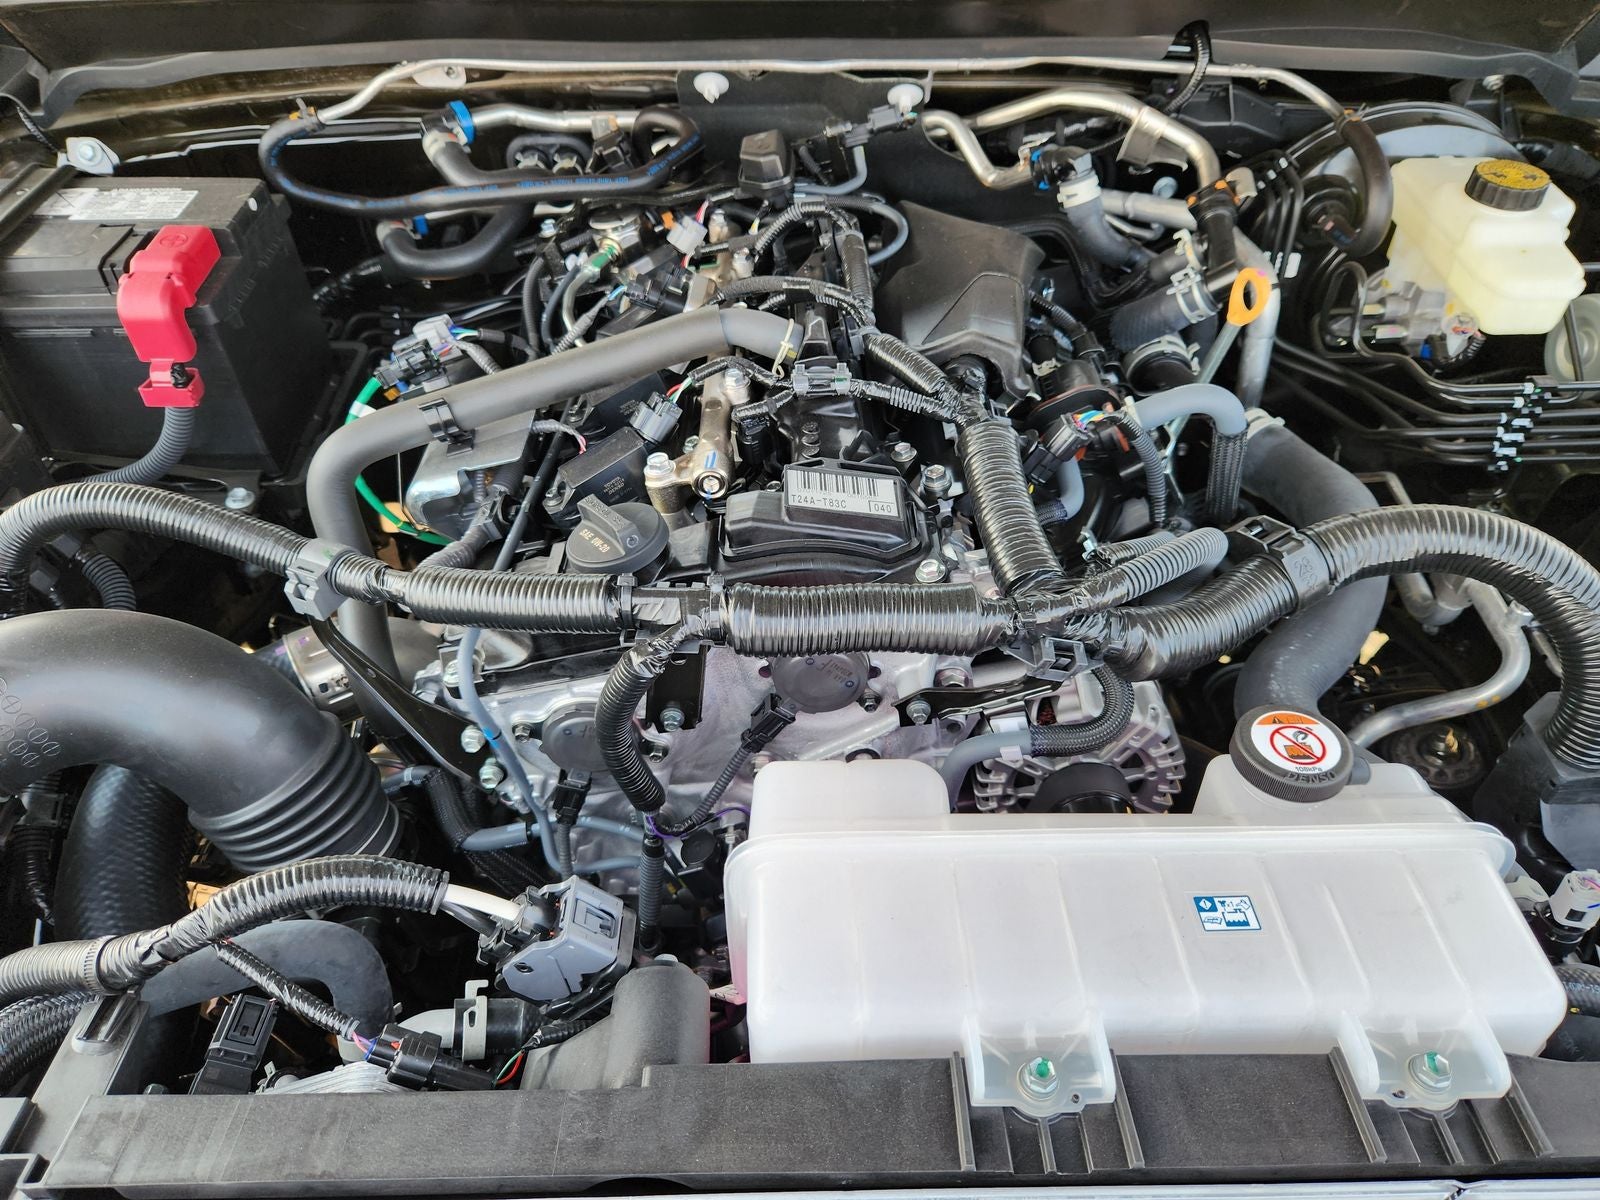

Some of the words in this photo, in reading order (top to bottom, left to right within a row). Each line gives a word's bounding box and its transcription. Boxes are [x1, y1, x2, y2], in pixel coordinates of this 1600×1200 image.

[791, 494, 847, 509] T24A-T83C
[874, 503, 892, 513] 040
[579, 528, 594, 540] SAE
[591, 537, 610, 553] 0W-20
[1285, 770, 1337, 784] DENSO
